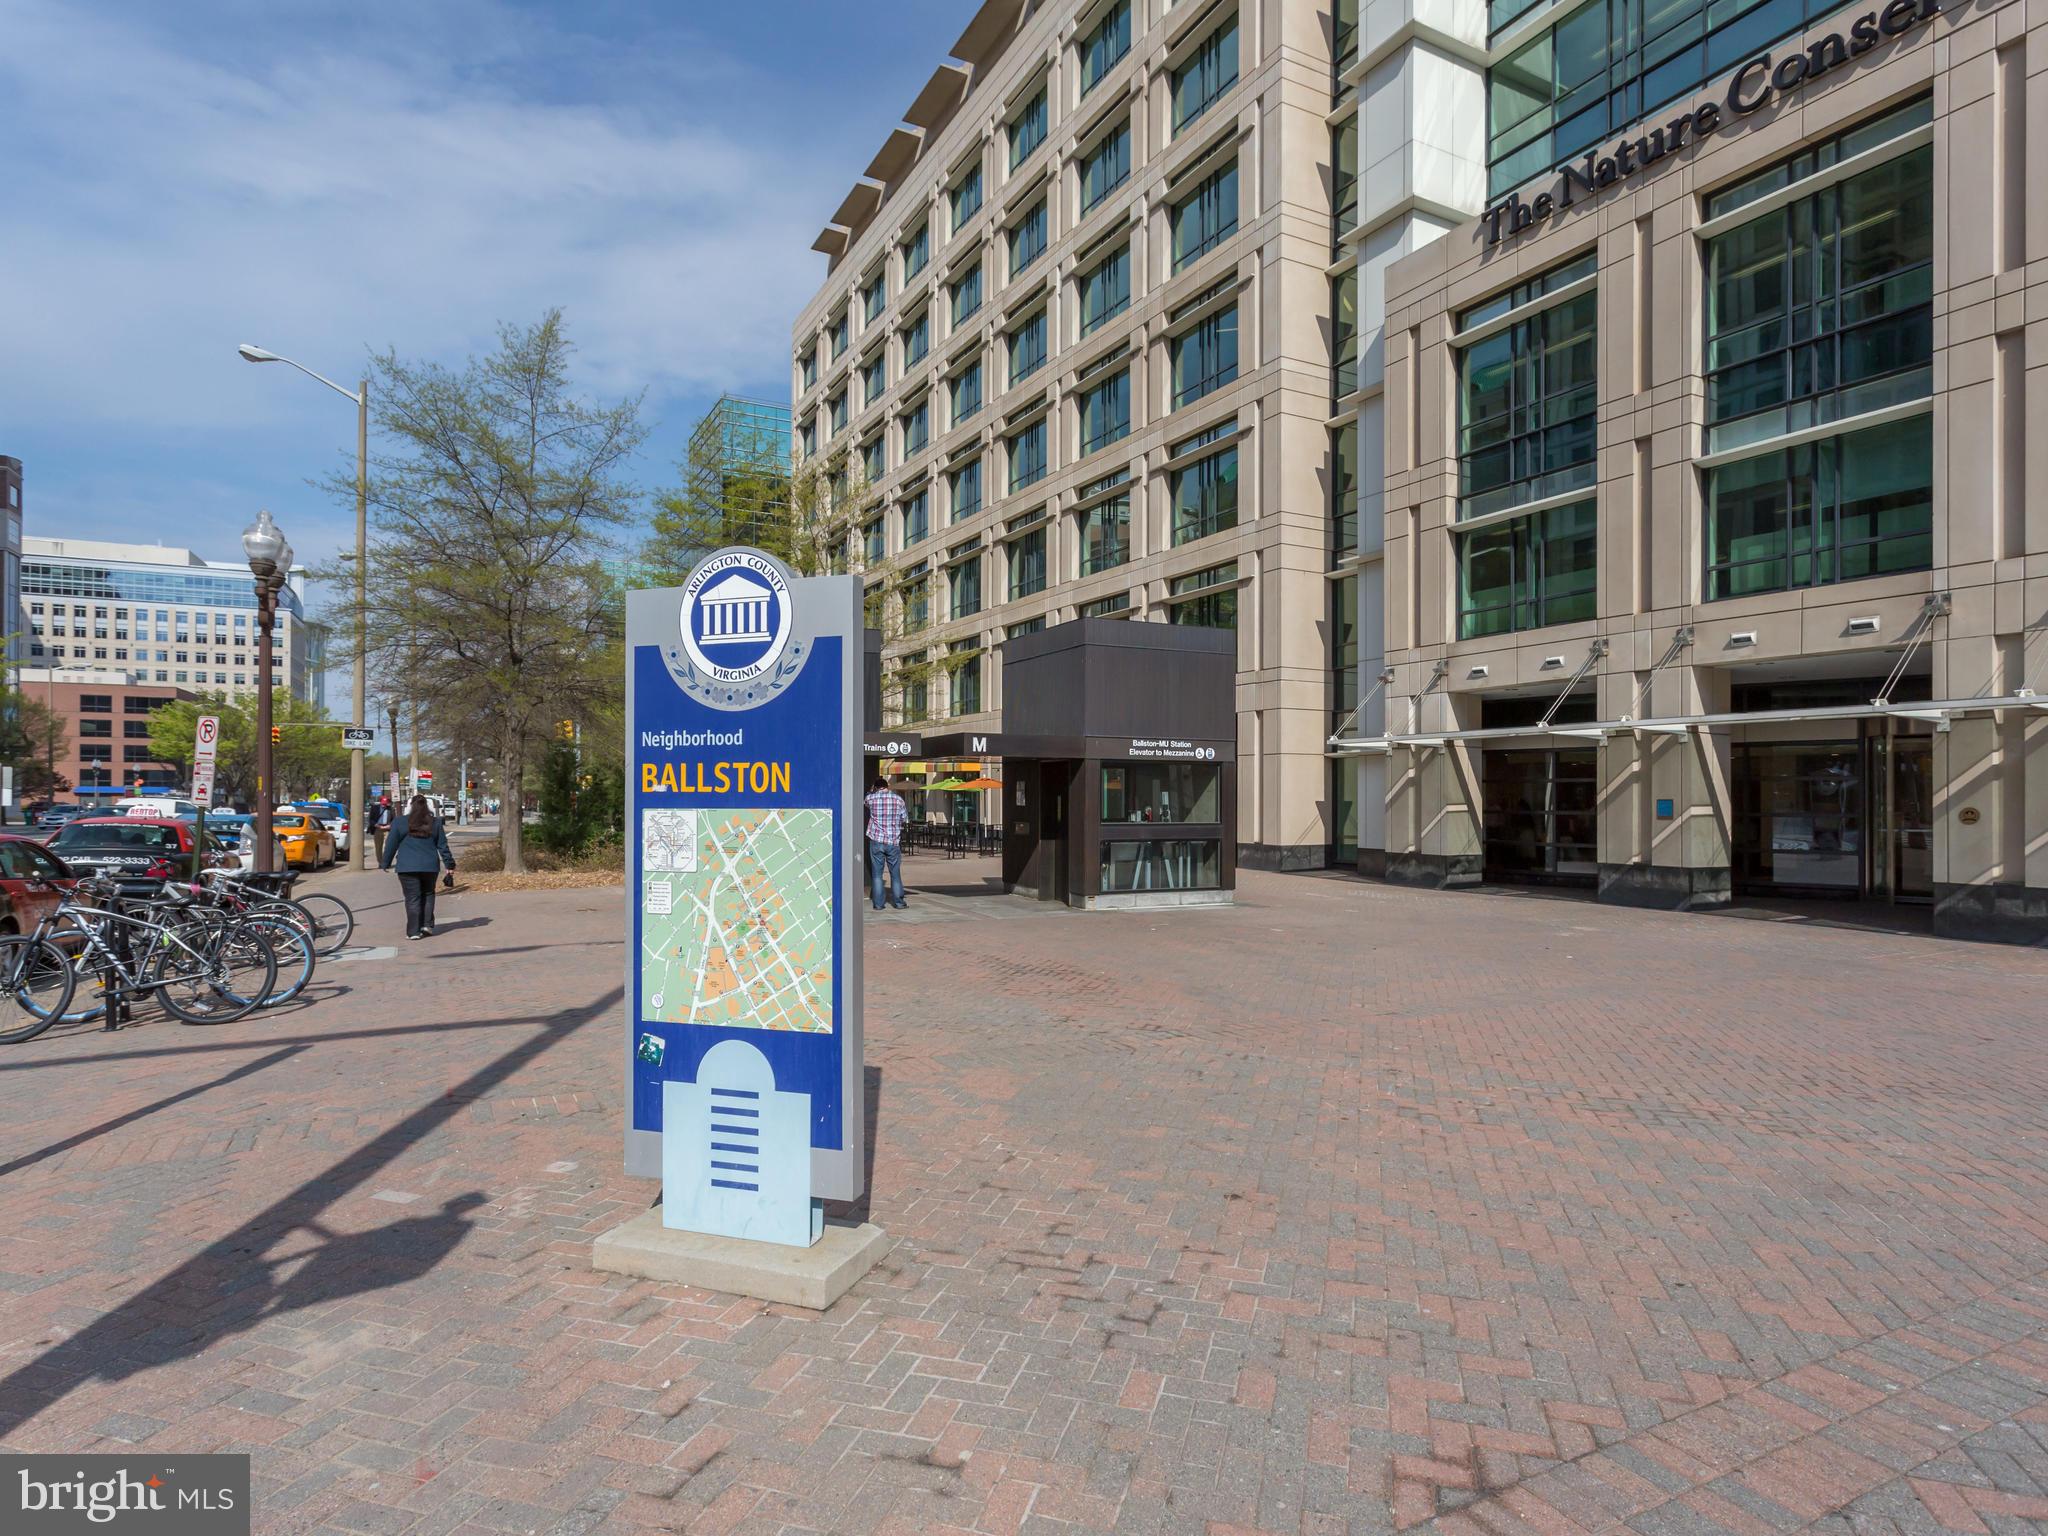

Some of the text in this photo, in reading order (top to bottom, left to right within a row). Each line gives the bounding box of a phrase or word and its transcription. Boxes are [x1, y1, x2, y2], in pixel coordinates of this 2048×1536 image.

[1482, 192, 1553, 245] The
[1559, 101, 1721, 209] Nature
[688, 555, 787, 598] ARLINGTON COUNTY
[713, 664, 762, 680] VIRGINIA
[642, 729, 743, 751] Neighborhood
[864, 743, 887, 752] Trains
[972, 737, 987, 752] M
[1132, 739, 1192, 748] Ballston-MU Station
[1129, 748, 1155, 756] Elevator
[1163, 749, 1195, 757] Mezzanine
[641, 761, 791, 793] BALLSTON
[103, 856, 150, 865] 522-3333
